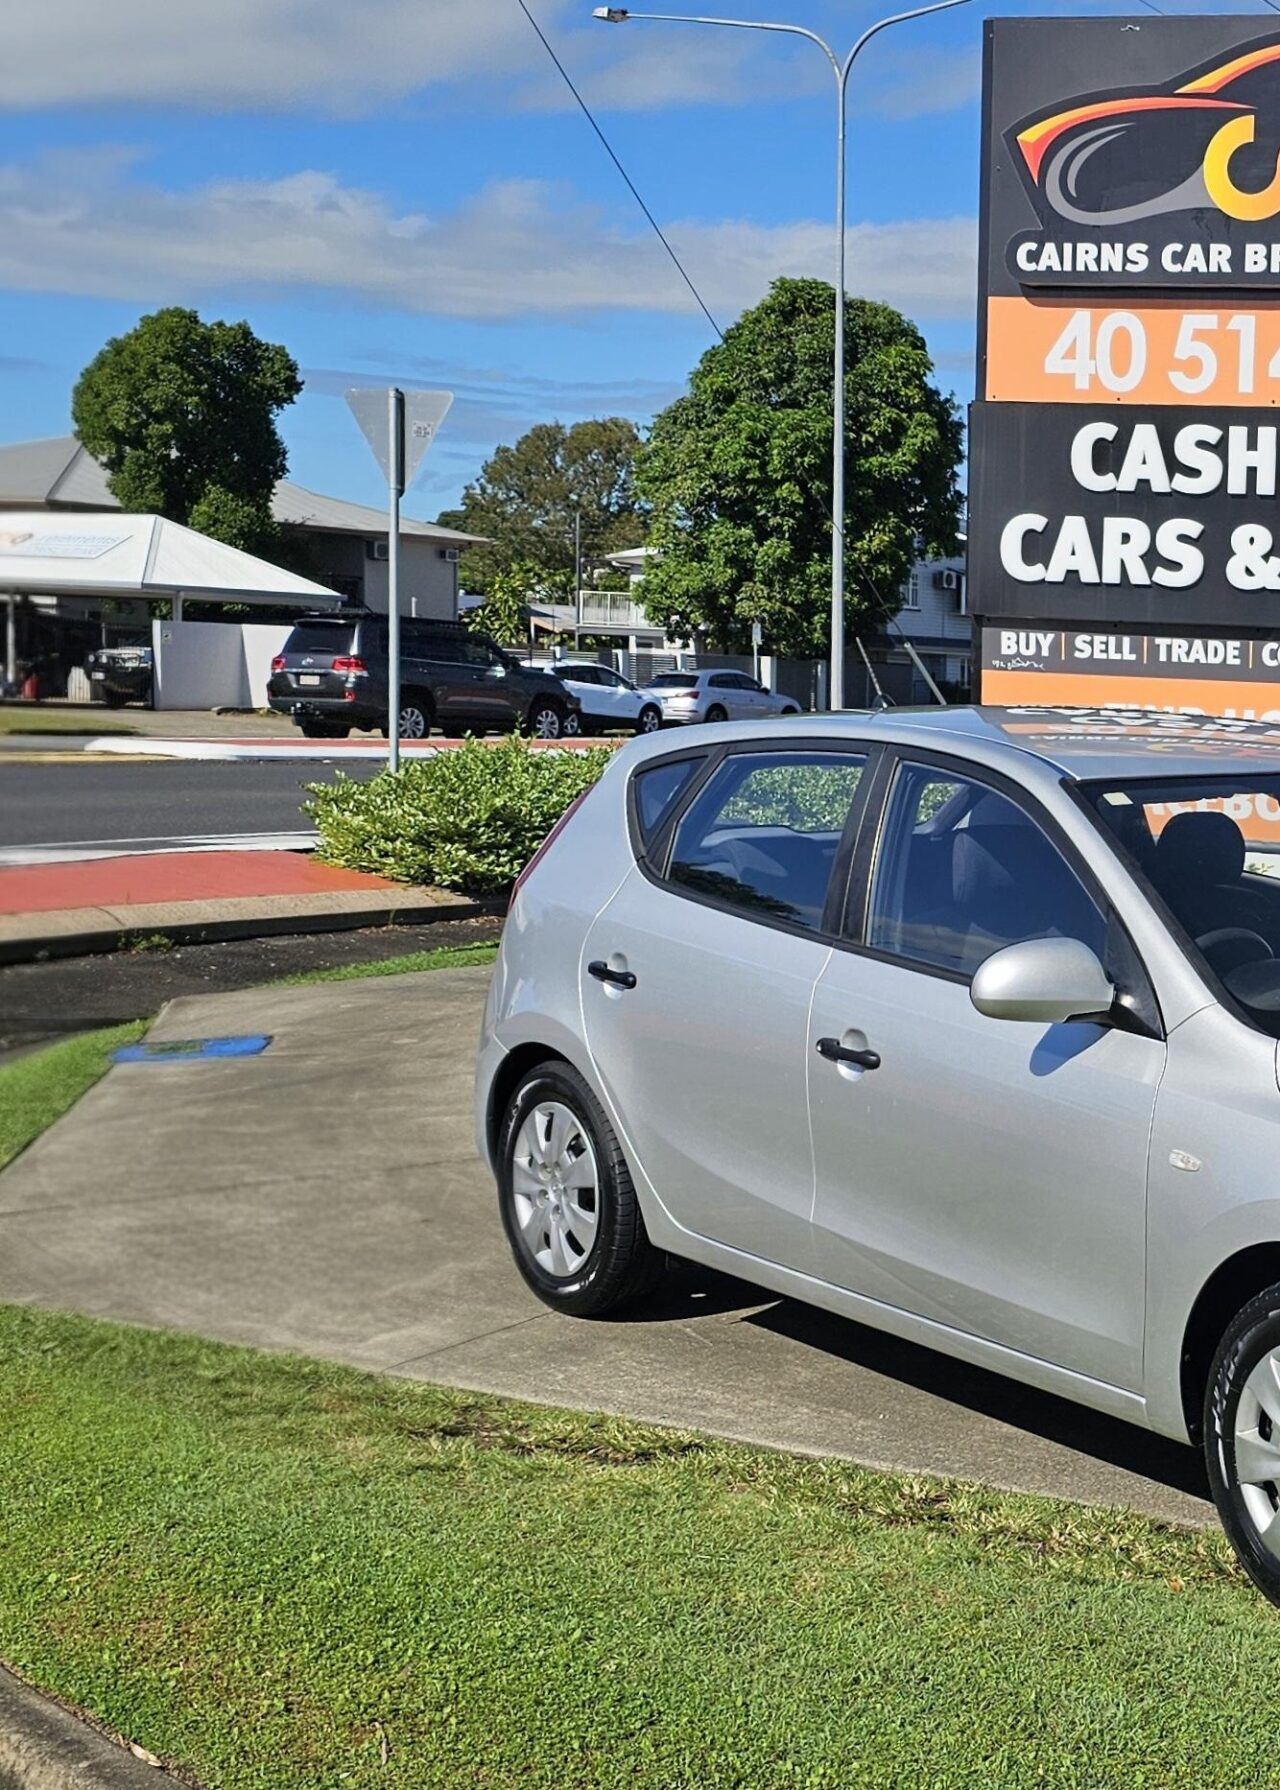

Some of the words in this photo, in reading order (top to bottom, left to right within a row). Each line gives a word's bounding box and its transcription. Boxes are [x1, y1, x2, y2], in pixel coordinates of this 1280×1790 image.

[1015, 241, 1149, 273] CAIRNS
[1160, 243, 1232, 274] CAR
[1044, 310, 1147, 394] 40
[1070, 421, 1277, 497] CASH
[1000, 513, 1205, 589] CARS
[1000, 631, 1055, 657] BUY
[1073, 634, 1137, 661] SELL
[1155, 638, 1241, 665] TRADE
